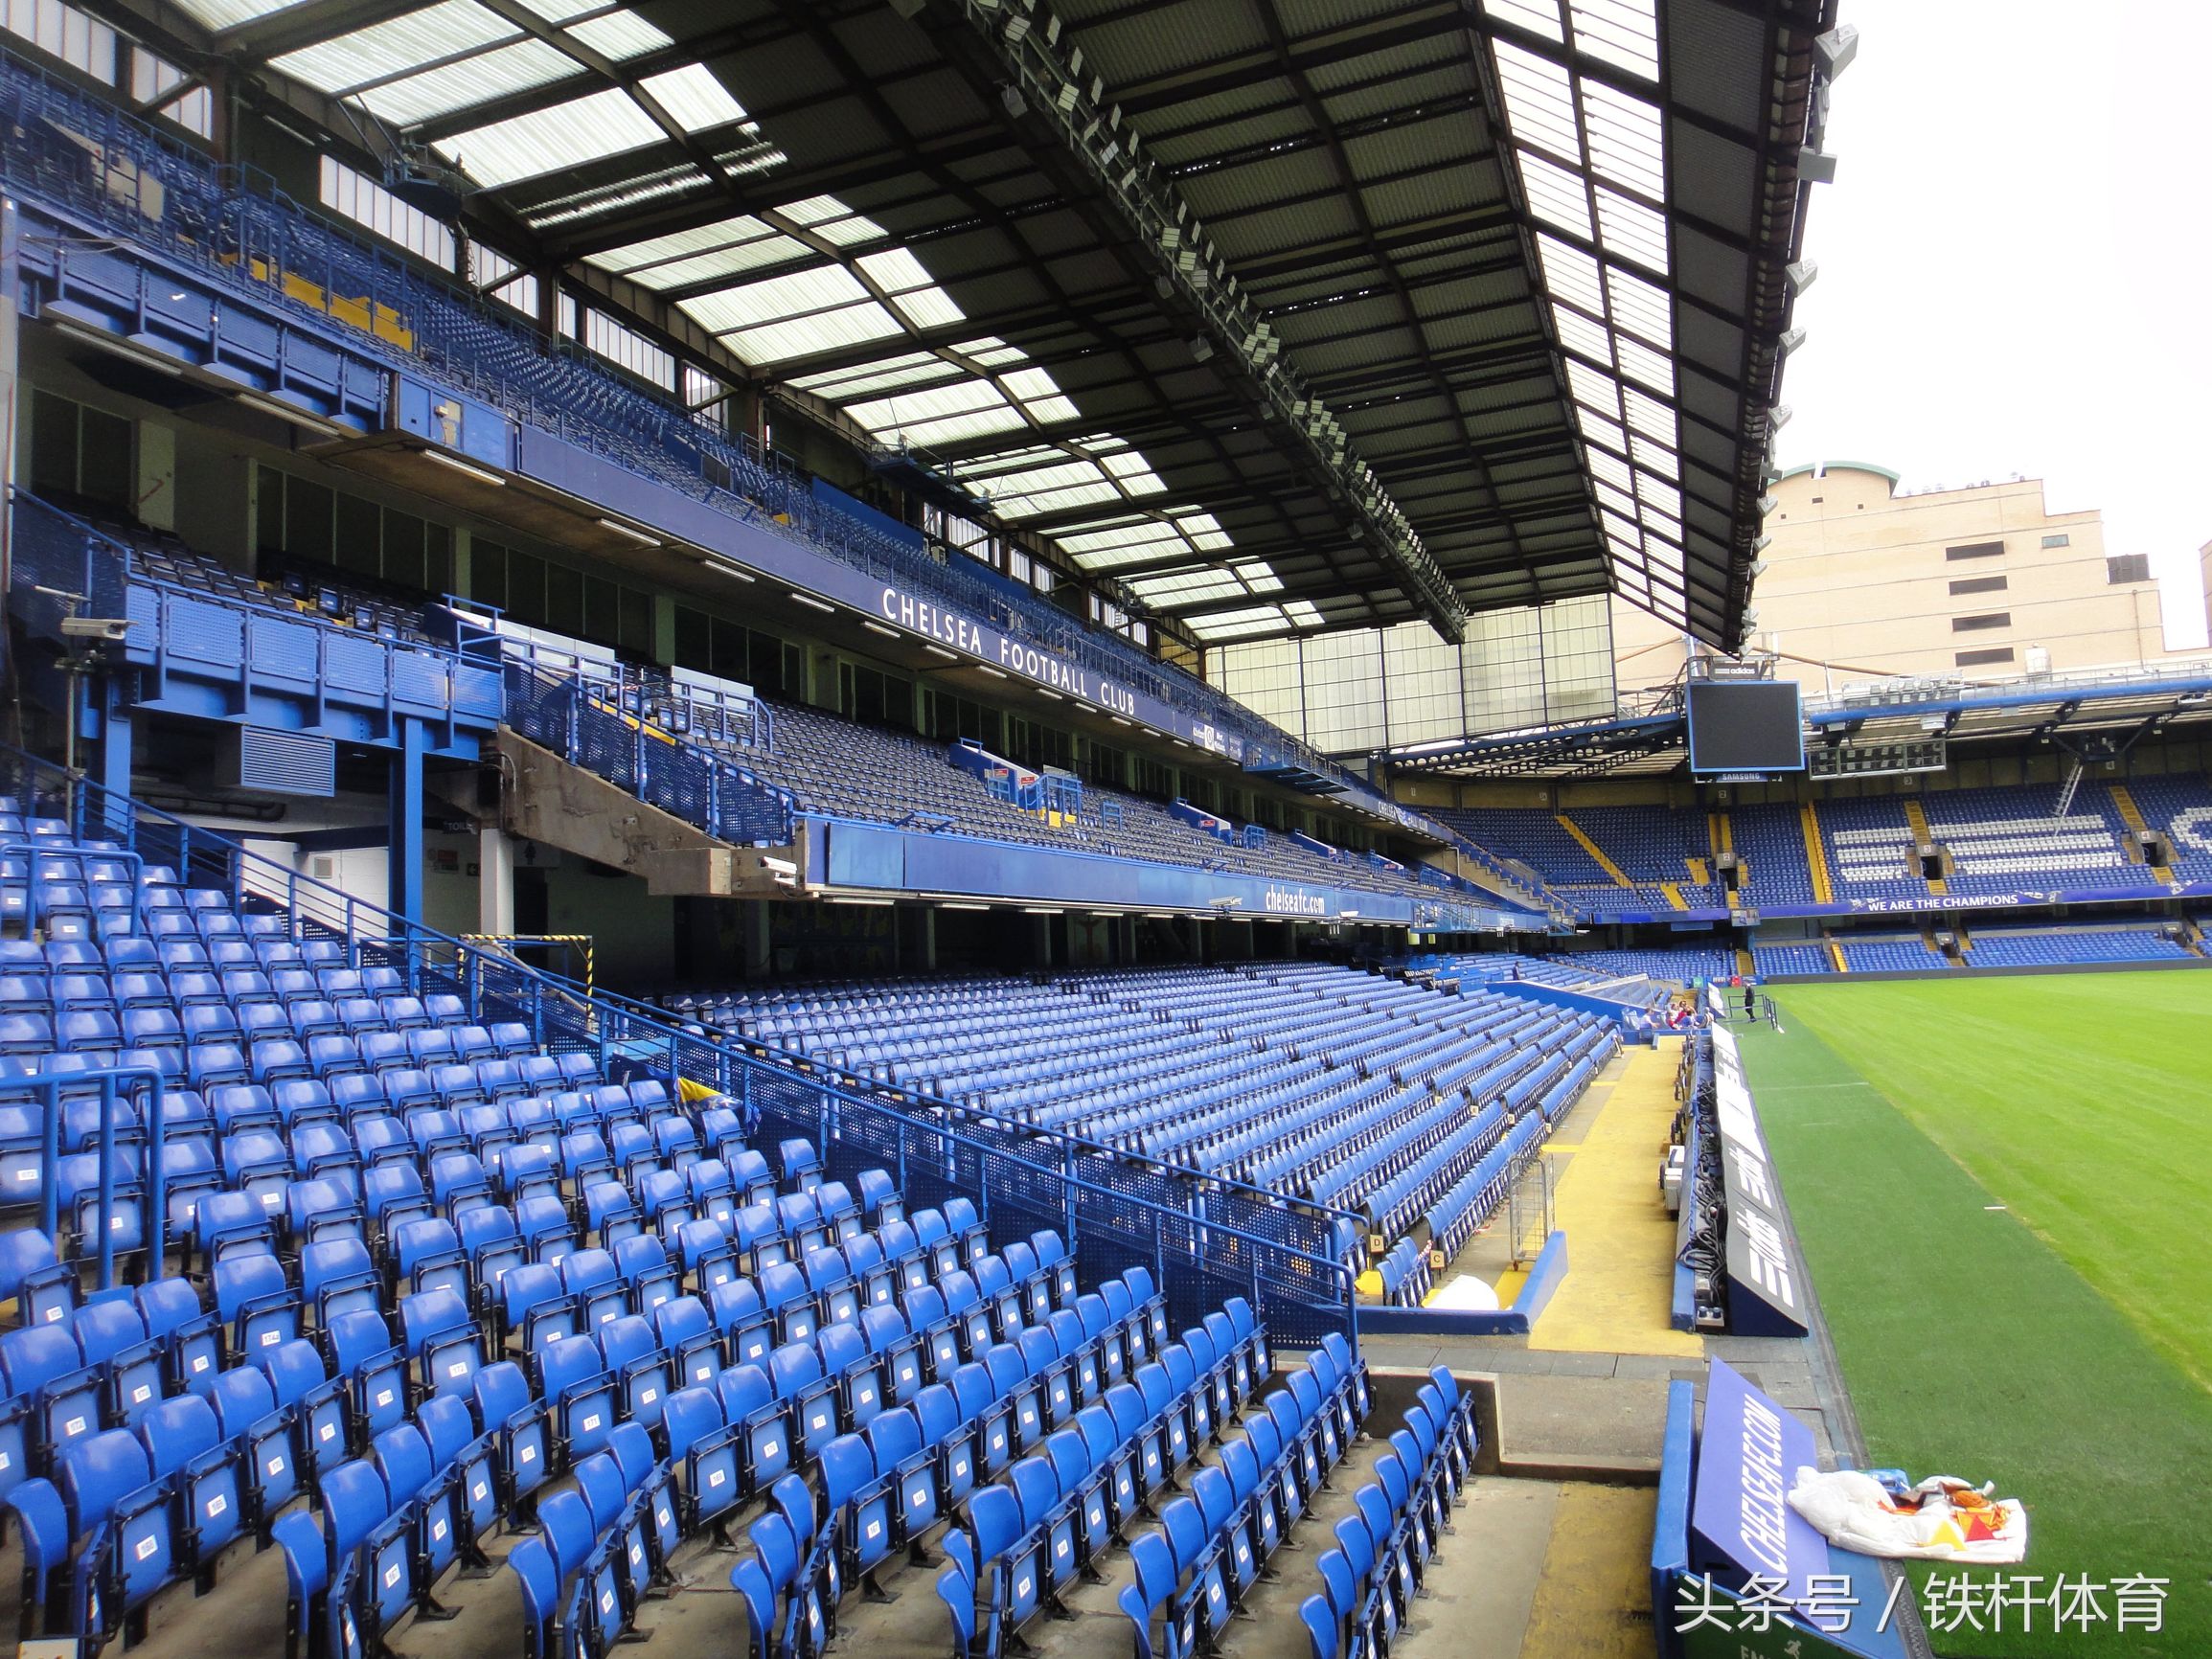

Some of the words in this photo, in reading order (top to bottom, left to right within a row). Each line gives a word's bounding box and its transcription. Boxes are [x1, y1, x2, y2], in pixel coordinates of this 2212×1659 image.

[882, 587, 982, 655] CHELSEA
[999, 638, 1088, 697] FOOTBALL
[1101, 681, 1136, 716] CLUB
[1722, 772, 1761, 781] SAMSUNG
[1266, 884, 1325, 914] chelseafc.com
[1869, 900, 1887, 912] WE
[1890, 899, 1913, 910] ARE
[1916, 898, 1940, 909] THE
[1942, 895, 2018, 908] CHAMPIONS
[1740, 1394, 1789, 1575] CHELSEAFC.COM
